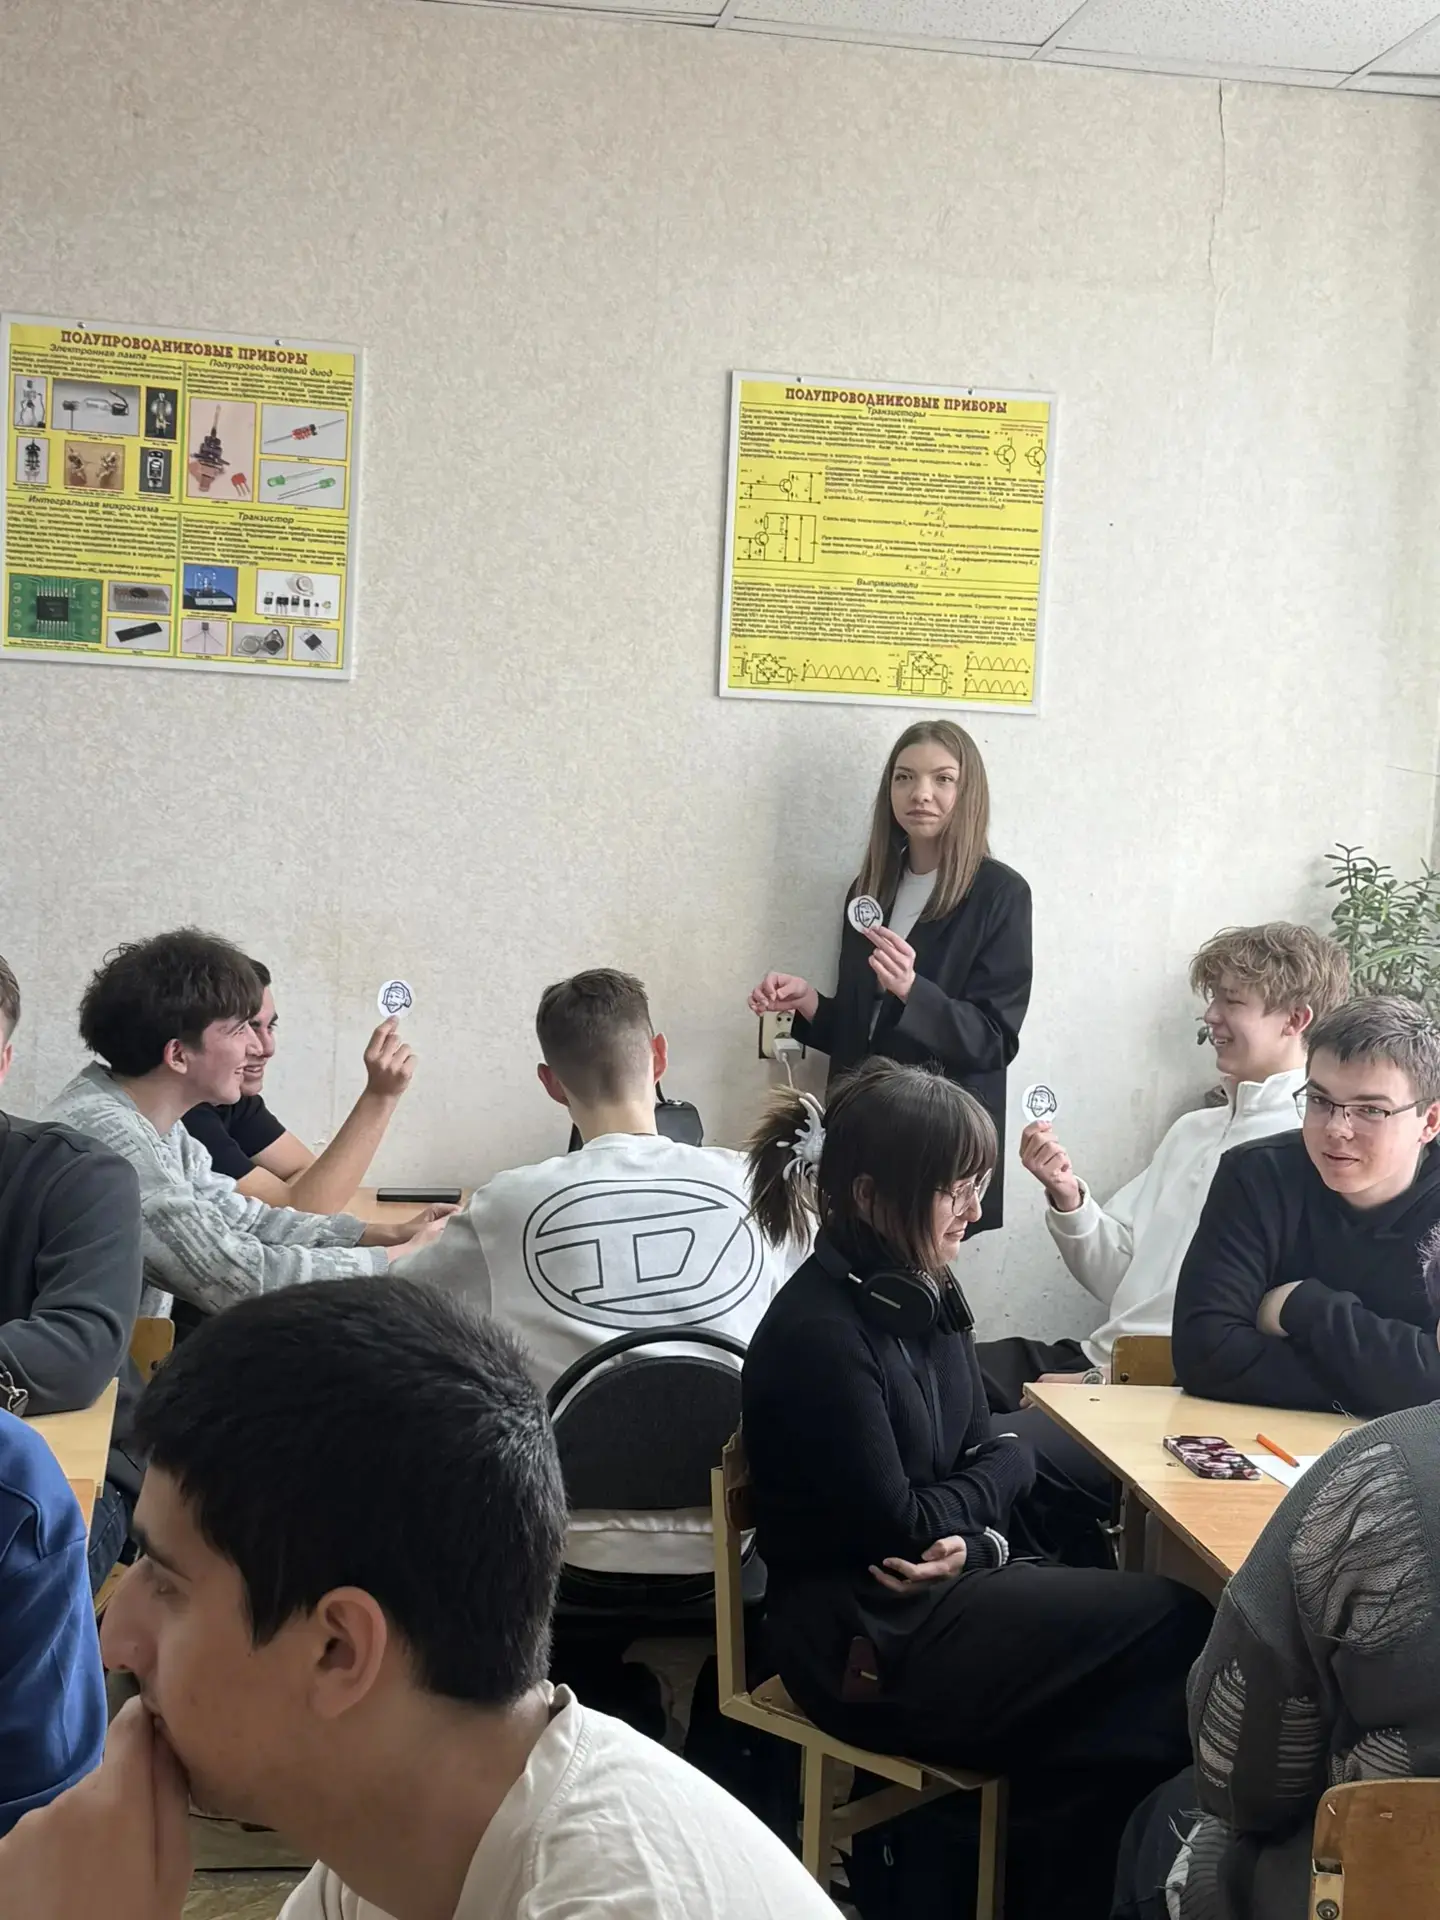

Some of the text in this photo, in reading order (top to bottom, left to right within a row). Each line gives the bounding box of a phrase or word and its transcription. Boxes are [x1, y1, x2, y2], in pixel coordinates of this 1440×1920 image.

[49, 343, 147, 360] Электронная лампа
[61, 330, 308, 365] ПОЛУПРОВОДНИКОВЫЕ ПРИБОРЫ
[209, 359, 333, 377] Полупроводниковый диод
[785, 388, 1008, 414] ПОЛУПРОВОДНИКОВЫЕ ПРИБОРЫ
[867, 406, 926, 419] Транзисторы
[28, 494, 160, 513] Интегральная микросхема
[238, 512, 295, 525] Транзистор
[856, 577, 919, 590] Выпрямители
